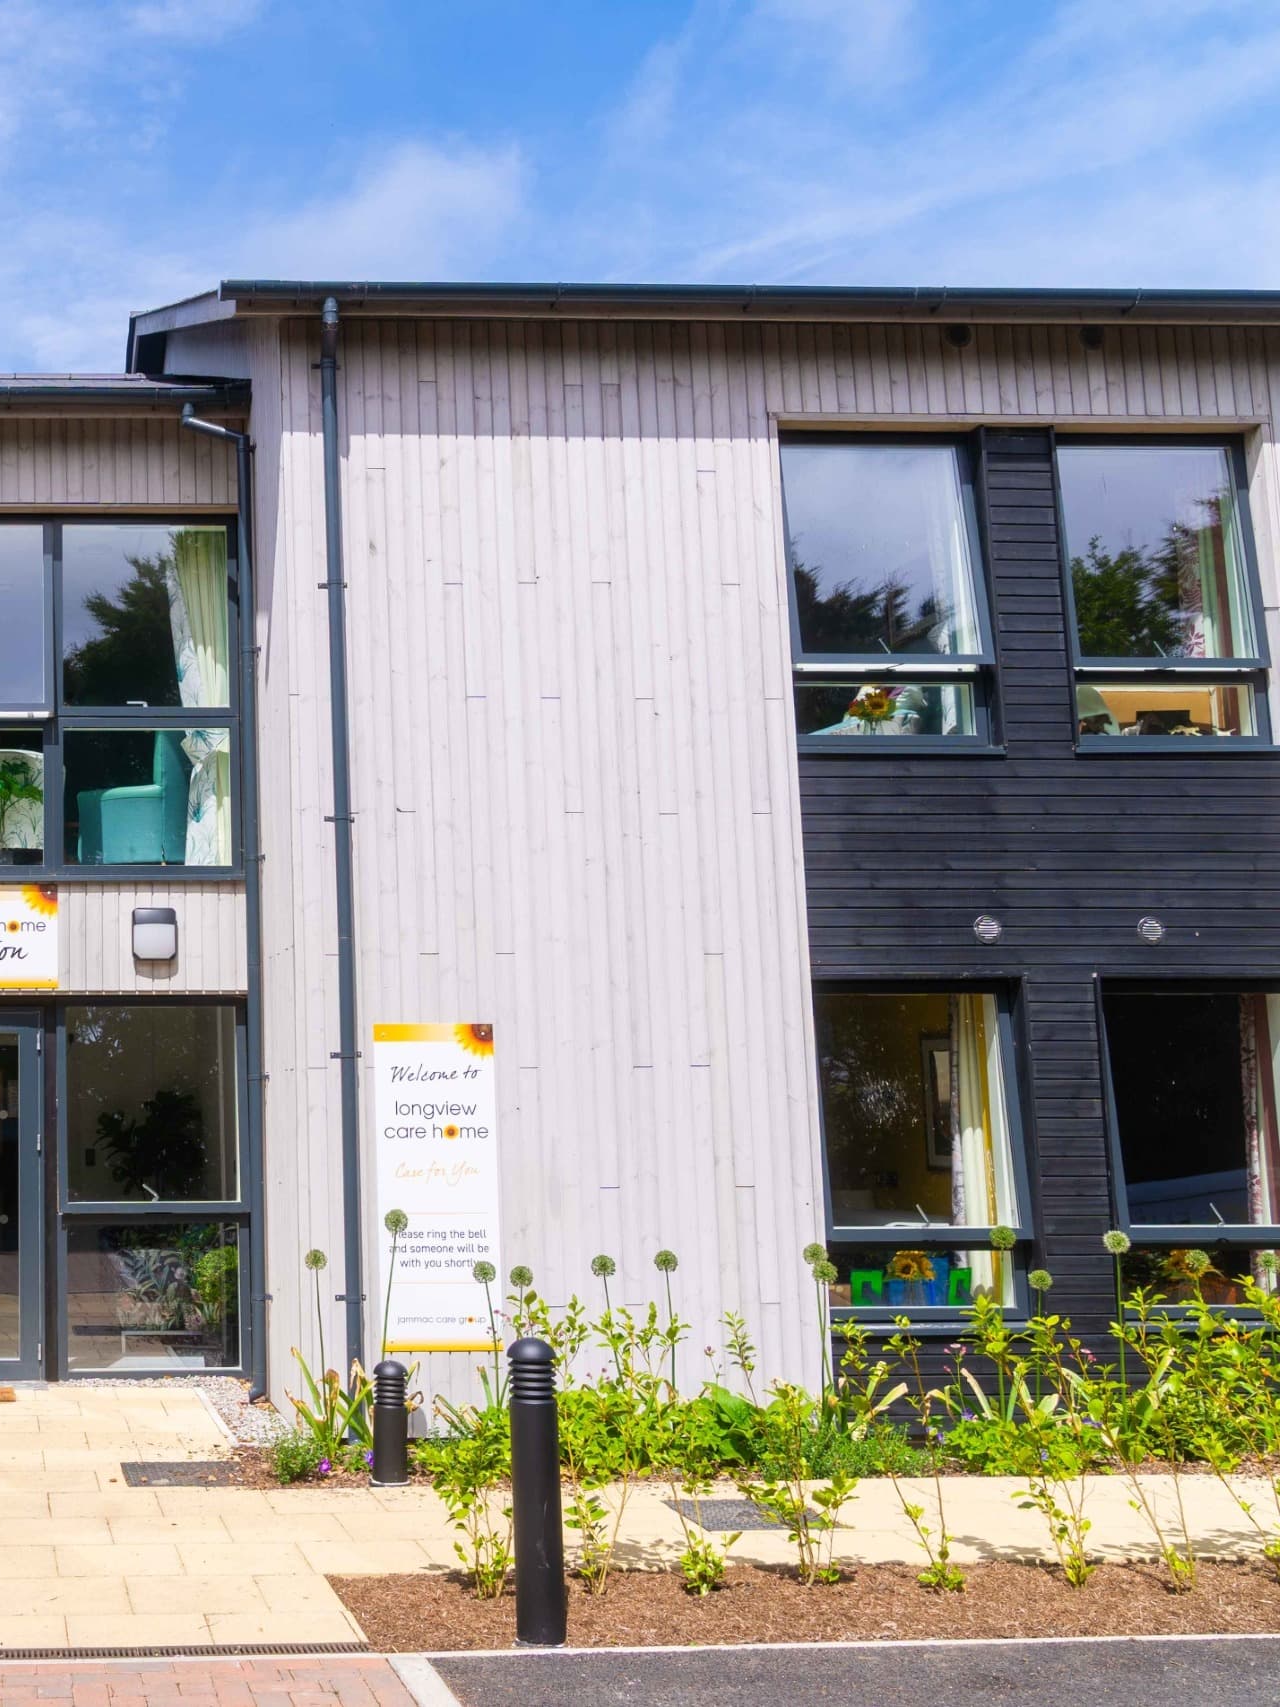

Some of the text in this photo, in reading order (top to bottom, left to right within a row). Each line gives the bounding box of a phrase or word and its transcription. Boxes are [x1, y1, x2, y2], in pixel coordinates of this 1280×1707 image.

[391, 1063, 482, 1083] Welcome to
[395, 1100, 477, 1120] longview
[384, 1125, 427, 1139] care
[426, 1228, 447, 1241] ring
[450, 1228, 465, 1239] the
[468, 1228, 487, 1239] bell
[409, 1244, 454, 1253] someone
[457, 1243, 475, 1253] will
[477, 1243, 489, 1253] be
[400, 1257, 421, 1268] with
[424, 1259, 442, 1270] you
[397, 1315, 433, 1325] jammac
[436, 1316, 457, 1324] care
